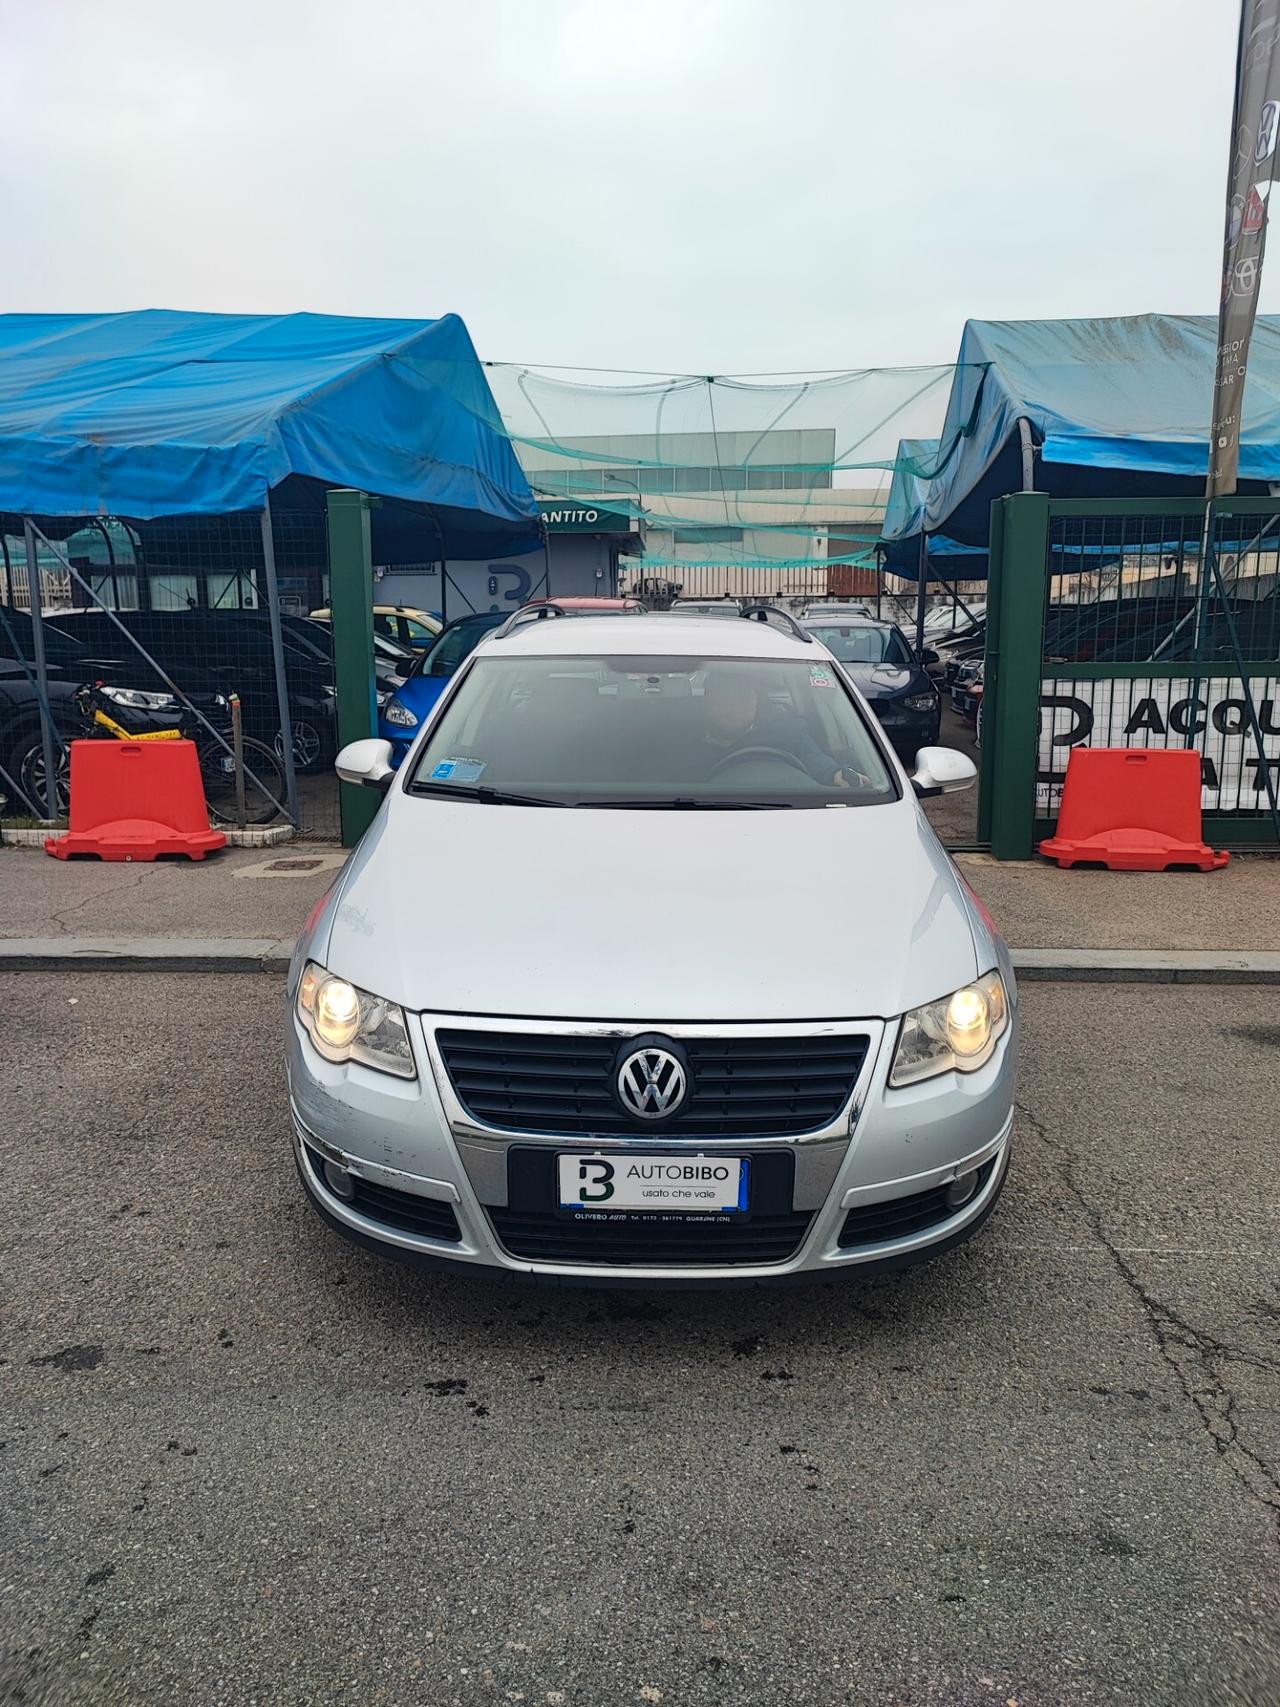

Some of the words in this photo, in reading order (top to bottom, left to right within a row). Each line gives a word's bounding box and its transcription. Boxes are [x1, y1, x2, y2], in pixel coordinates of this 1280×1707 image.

[626, 1164, 729, 1181] AUTOBIBO
[642, 1189, 670, 1199] usato
[672, 1189, 692, 1199] che
[694, 1189, 716, 1199] vale
[574, 1213, 608, 1221] OLIVERO
